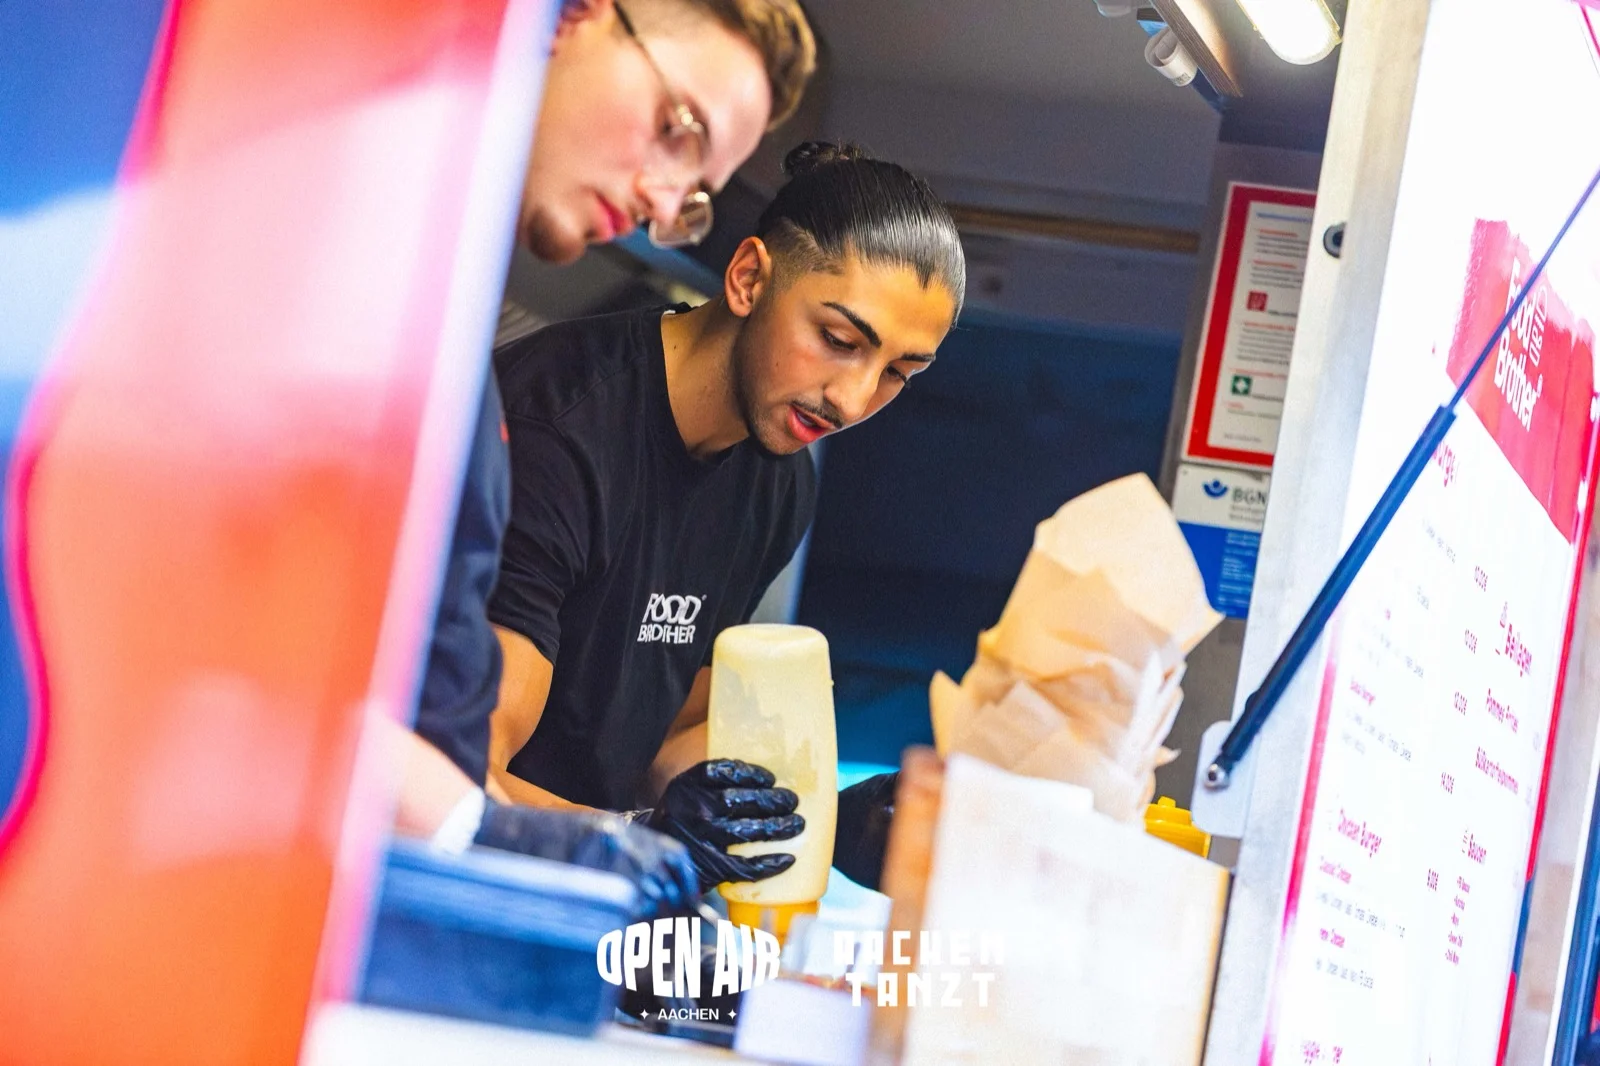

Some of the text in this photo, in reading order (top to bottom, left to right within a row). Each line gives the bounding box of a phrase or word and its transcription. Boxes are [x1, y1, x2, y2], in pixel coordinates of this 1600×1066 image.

[1494, 326, 1537, 432] Brother
[1232, 487, 1267, 505] BGN
[641, 592, 702, 625] FOOD
[637, 623, 696, 644] BROTHER
